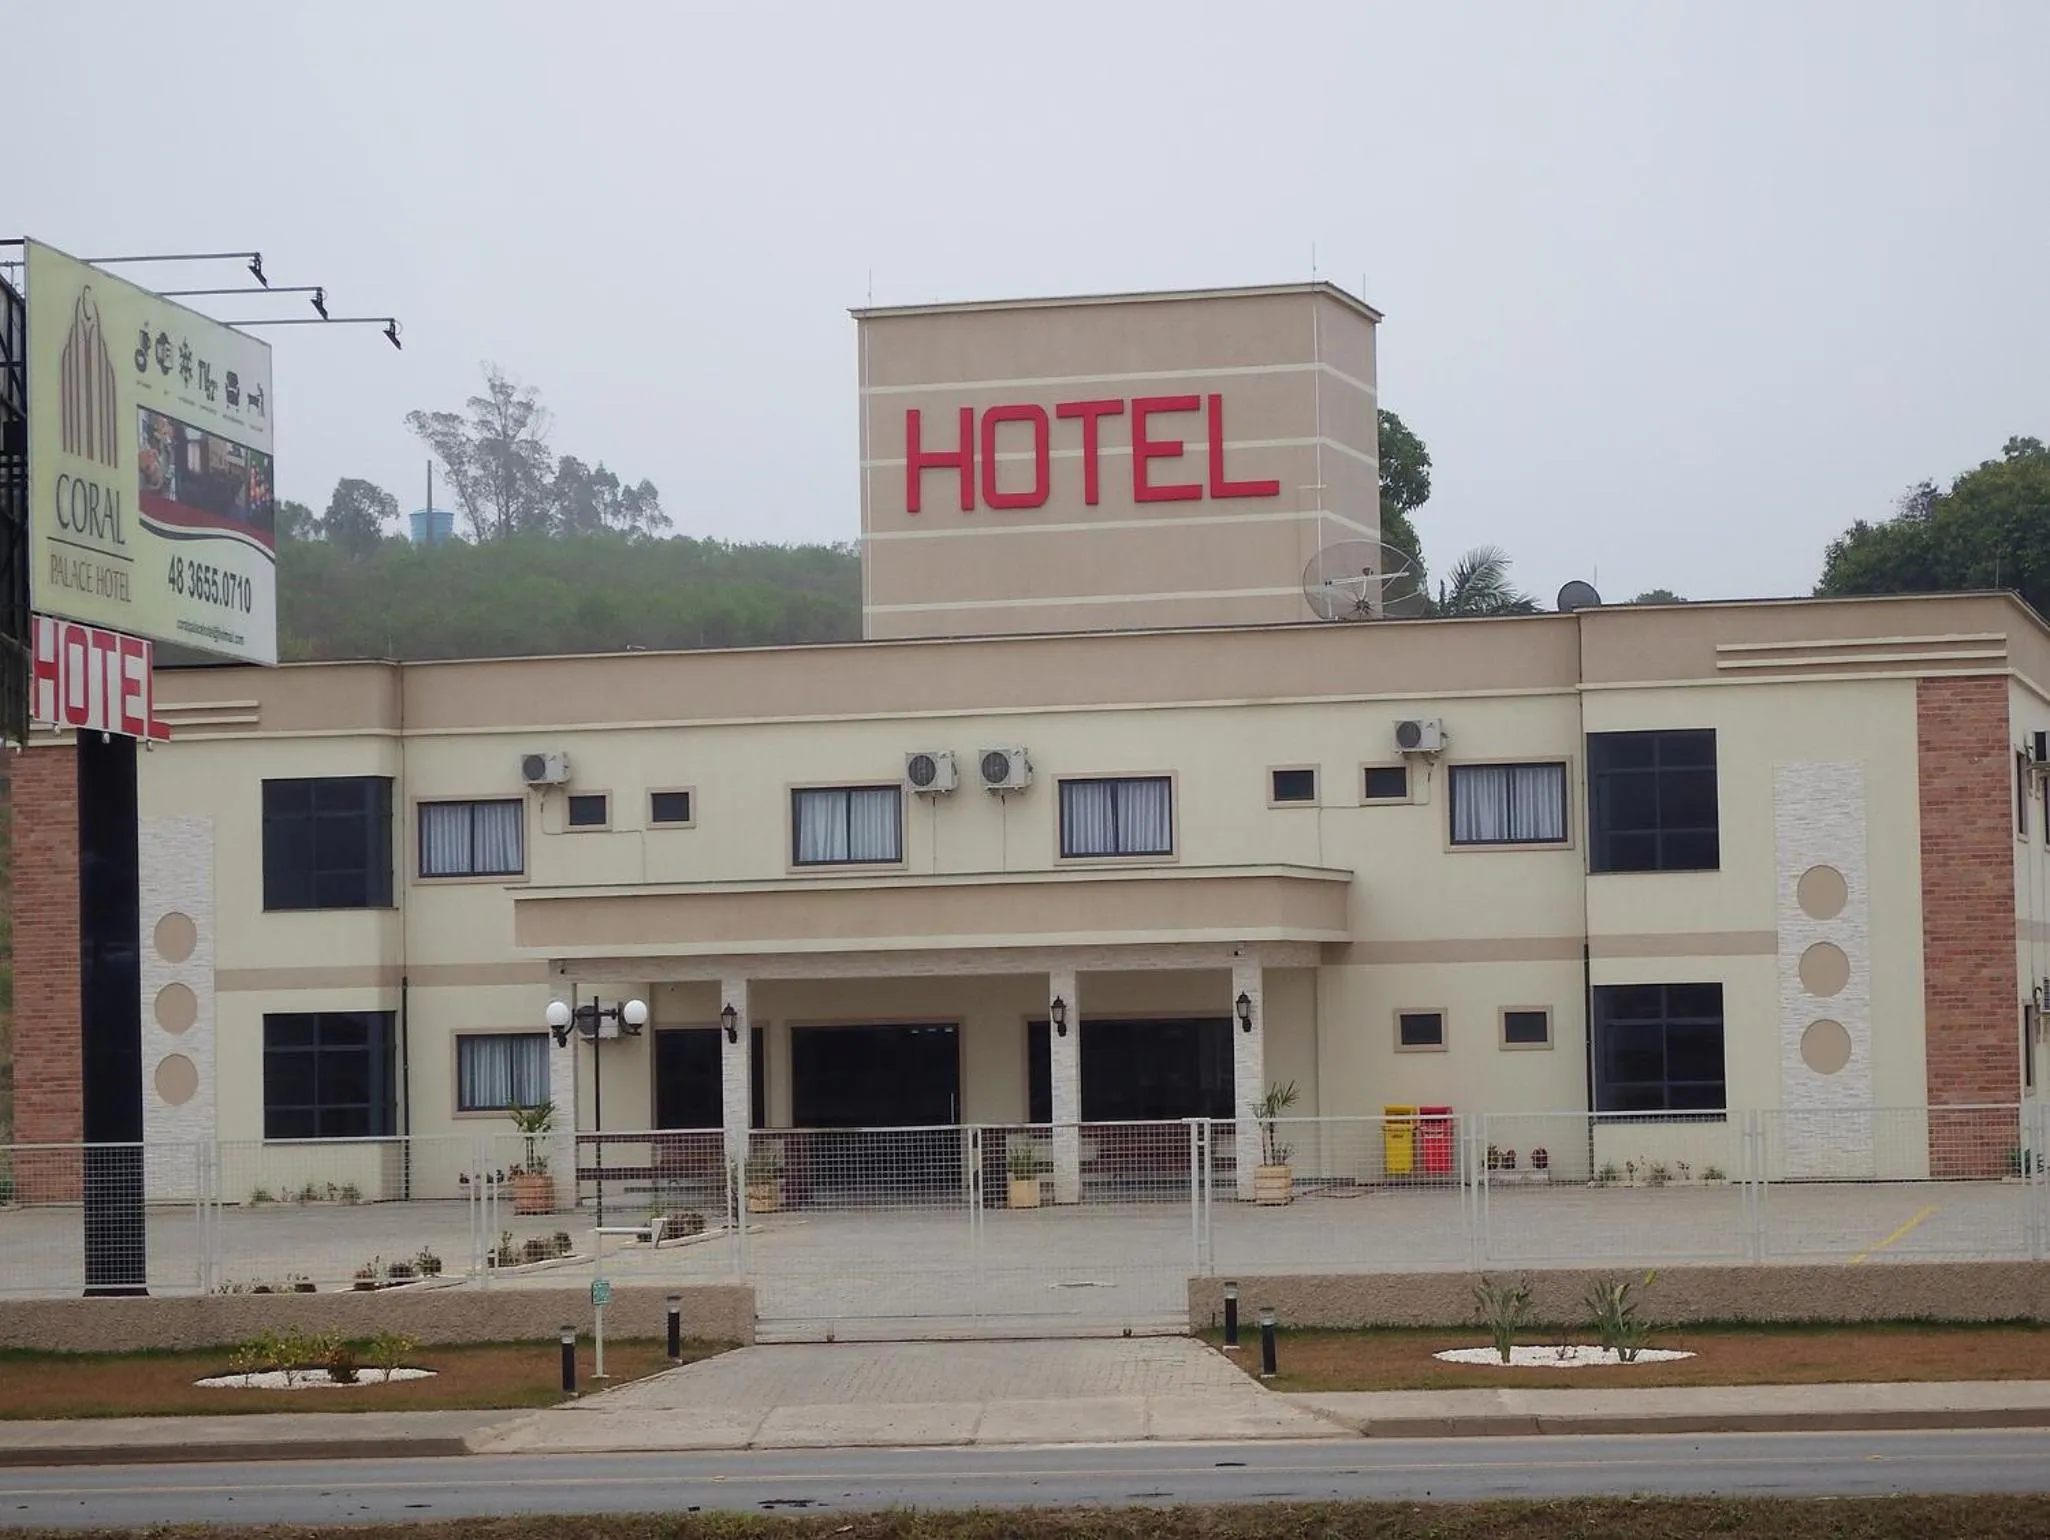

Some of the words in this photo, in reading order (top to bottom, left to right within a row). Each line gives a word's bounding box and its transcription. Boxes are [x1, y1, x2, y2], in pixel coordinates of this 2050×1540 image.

[907, 394, 1279, 513] HOTEL
[57, 474, 125, 545] CORAL
[50, 553, 92, 593] PALACE
[97, 567, 131, 603] HOTEL
[168, 555, 184, 596] 48
[188, 560, 251, 614] 3655.0710
[33, 617, 170, 742] HOTEL
